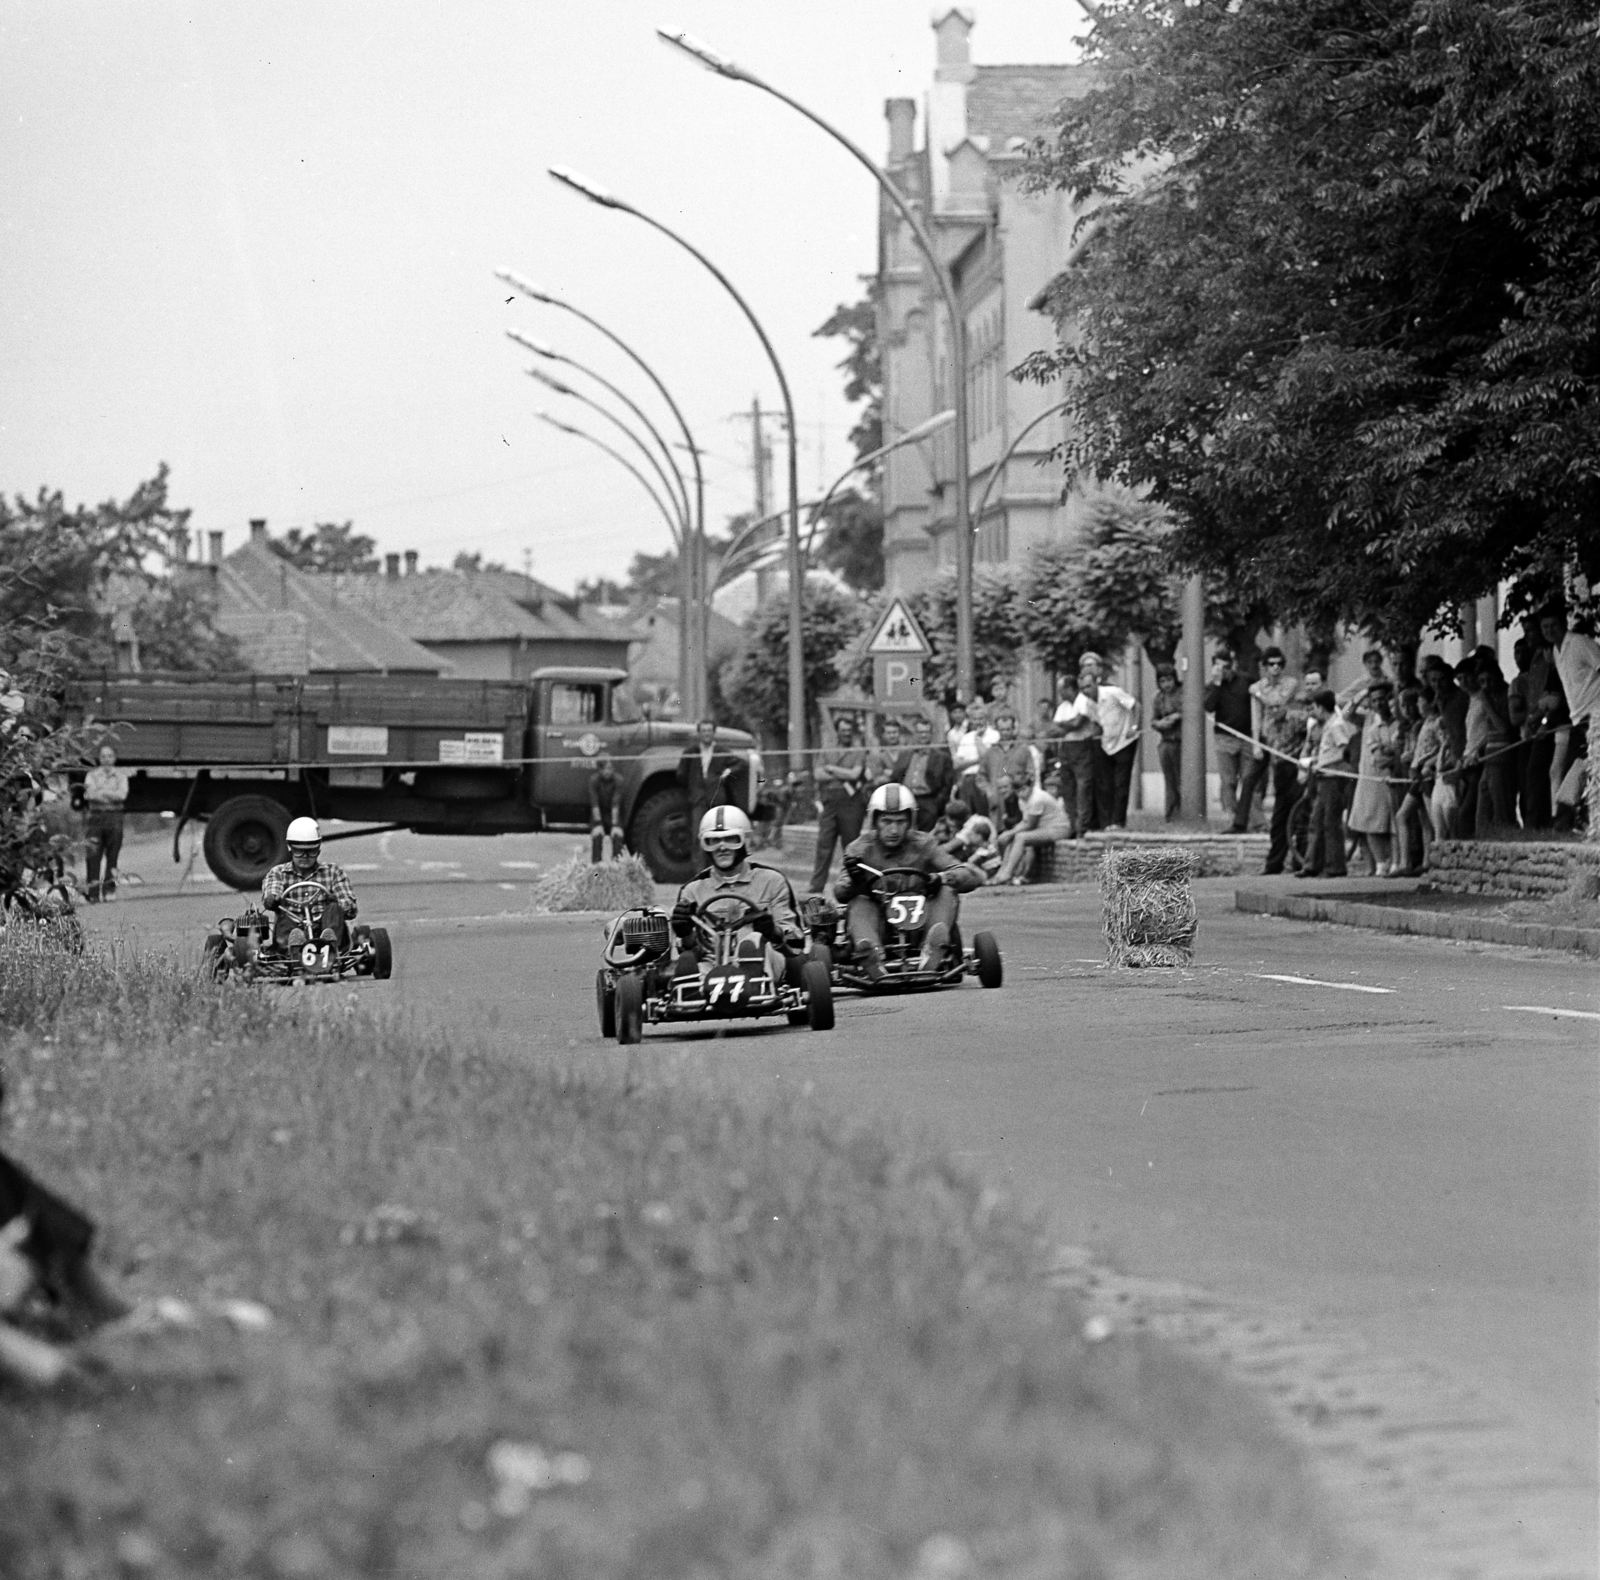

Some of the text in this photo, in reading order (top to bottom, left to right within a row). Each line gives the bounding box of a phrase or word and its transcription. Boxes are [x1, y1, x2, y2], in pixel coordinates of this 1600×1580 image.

[886, 661, 908, 697] P
[887, 895, 926, 923] 57
[302, 943, 330, 968] 61
[708, 975, 746, 1003] 77
